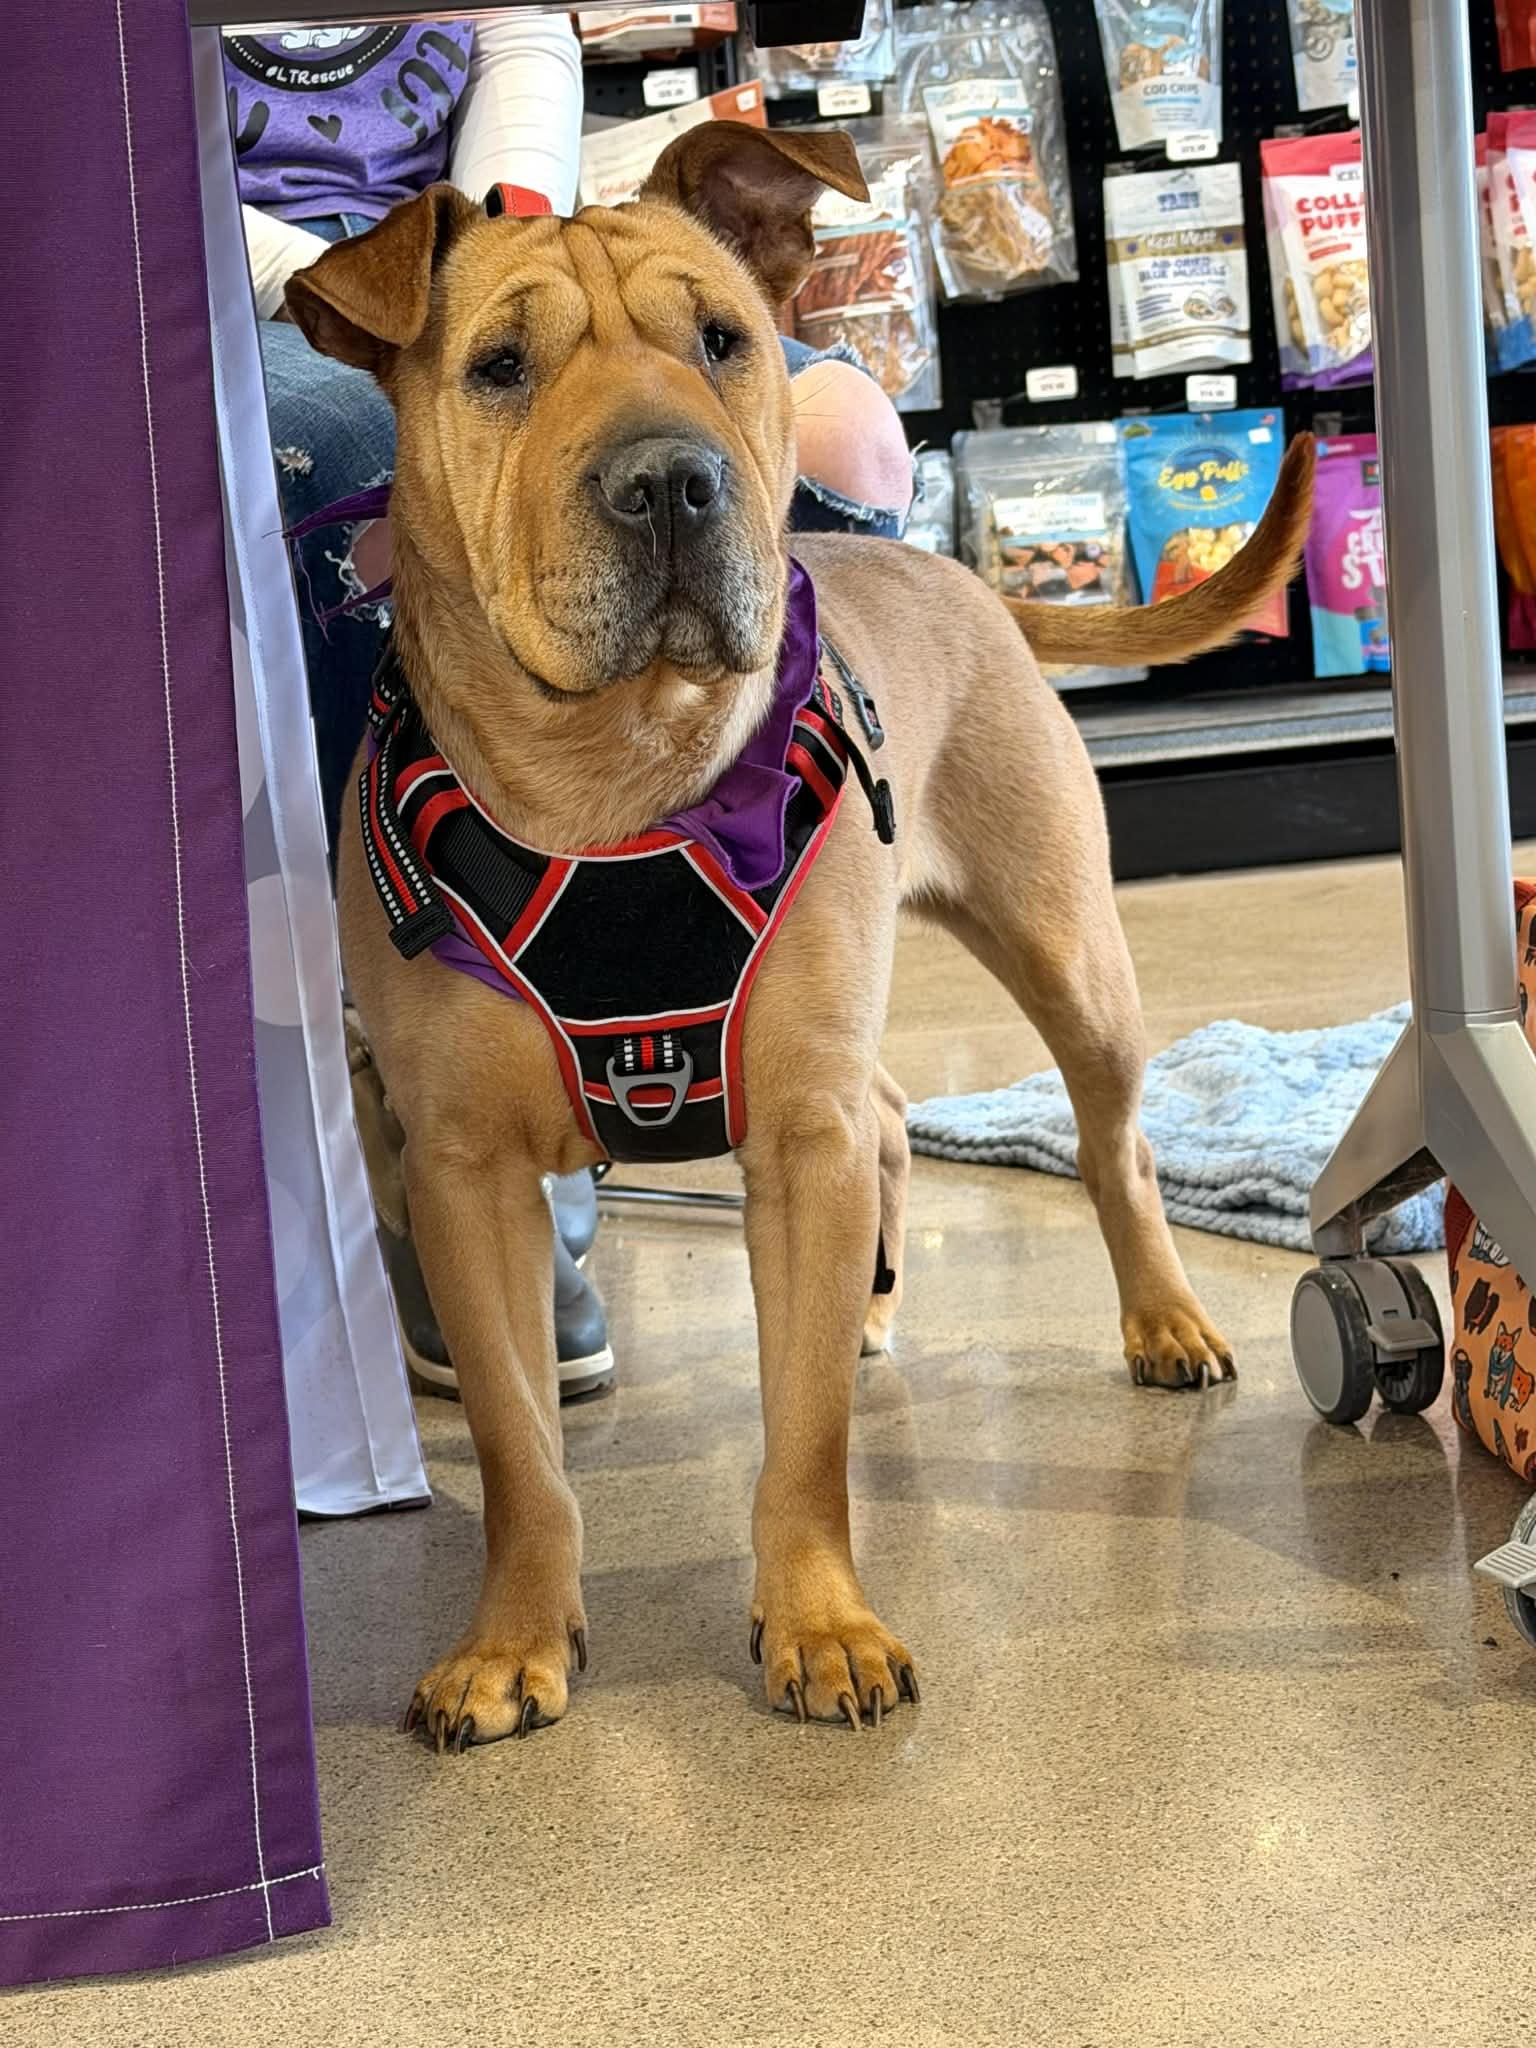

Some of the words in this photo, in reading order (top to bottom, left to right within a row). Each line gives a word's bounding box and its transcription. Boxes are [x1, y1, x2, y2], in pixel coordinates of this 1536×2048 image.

[265, 63, 354, 86] #LTRescue
[1296, 192, 1365, 214] COLL
[1138, 268, 1169, 282] BLUE
[1157, 466, 1200, 492] Egg
[1199, 460, 1250, 482] Puffs
